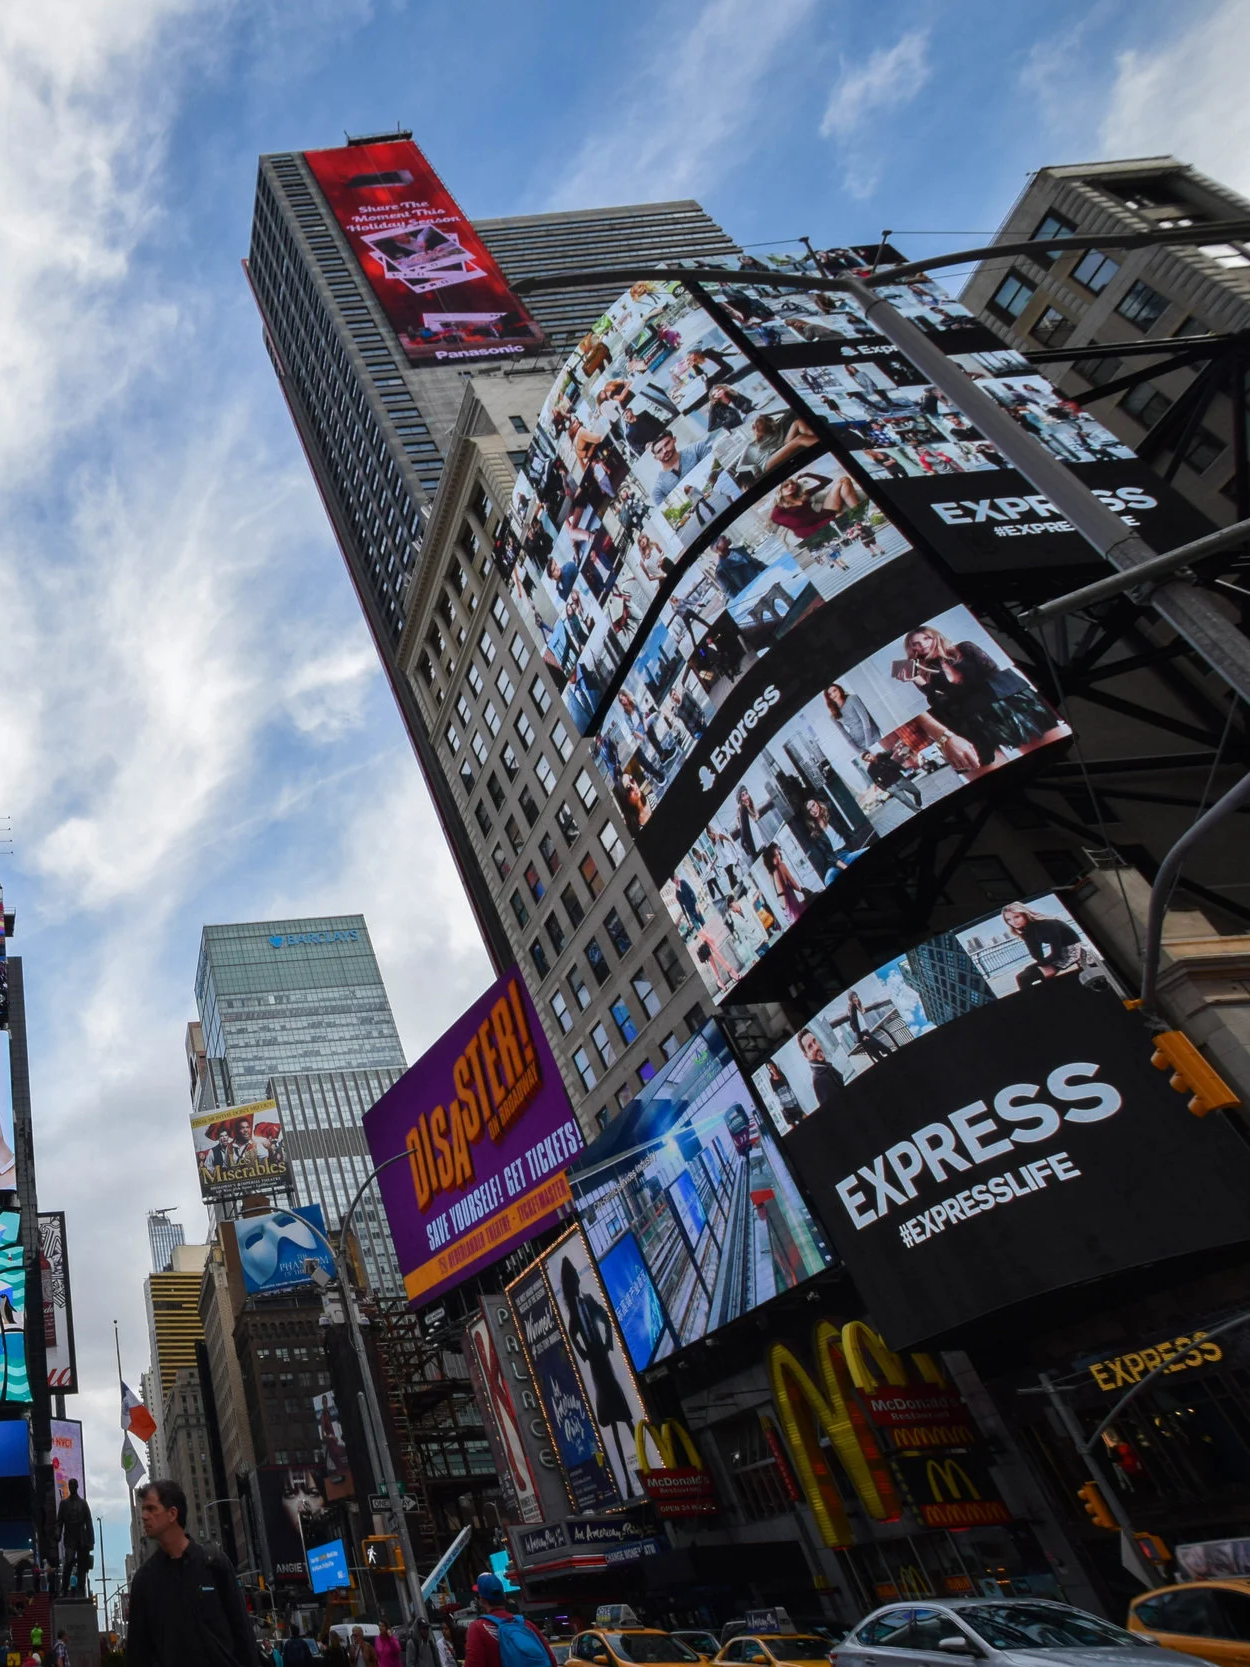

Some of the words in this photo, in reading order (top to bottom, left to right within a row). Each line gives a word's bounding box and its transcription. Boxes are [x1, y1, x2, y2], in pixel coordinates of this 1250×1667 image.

[351, 209, 409, 223] Moment
[412, 207, 445, 217] This
[358, 202, 398, 214] Share
[400, 199, 429, 210] The
[347, 222, 408, 234] Holiday
[435, 343, 525, 360] Panasonic
[857, 345, 899, 355] Expr
[931, 487, 1158, 525] EXPRSS
[994, 515, 1141, 537] #EXPREE
[709, 683, 782, 776] Express
[287, 930, 359, 946] BARCLAYS
[405, 979, 536, 1211] DISASTER!
[488, 1116, 502, 1141] ON
[498, 1062, 539, 1124] BROADWAY
[835, 1062, 1123, 1230] EXPRESS
[230, 1153, 250, 1167] Les
[201, 1159, 287, 1185] Misérables
[426, 1212, 450, 1252] SAVE
[449, 1174, 504, 1235] YOURSELF!
[503, 1157, 526, 1197] GET
[525, 1118, 585, 1181] TICKETS!
[900, 1151, 1082, 1249] #EXPRESSLIFE
[279, 1255, 329, 1272] PHANOM
[1089, 1331, 1223, 1391] EXPRESS
[497, 1307, 555, 1468] PALACE
[870, 1396, 959, 1411] McDonald's
[890, 1410, 950, 1421] Restaurant
[646, 1475, 710, 1488] McDonald's
[660, 1504, 680, 1512] OPEN
[276, 1562, 303, 1573] ANGIE
